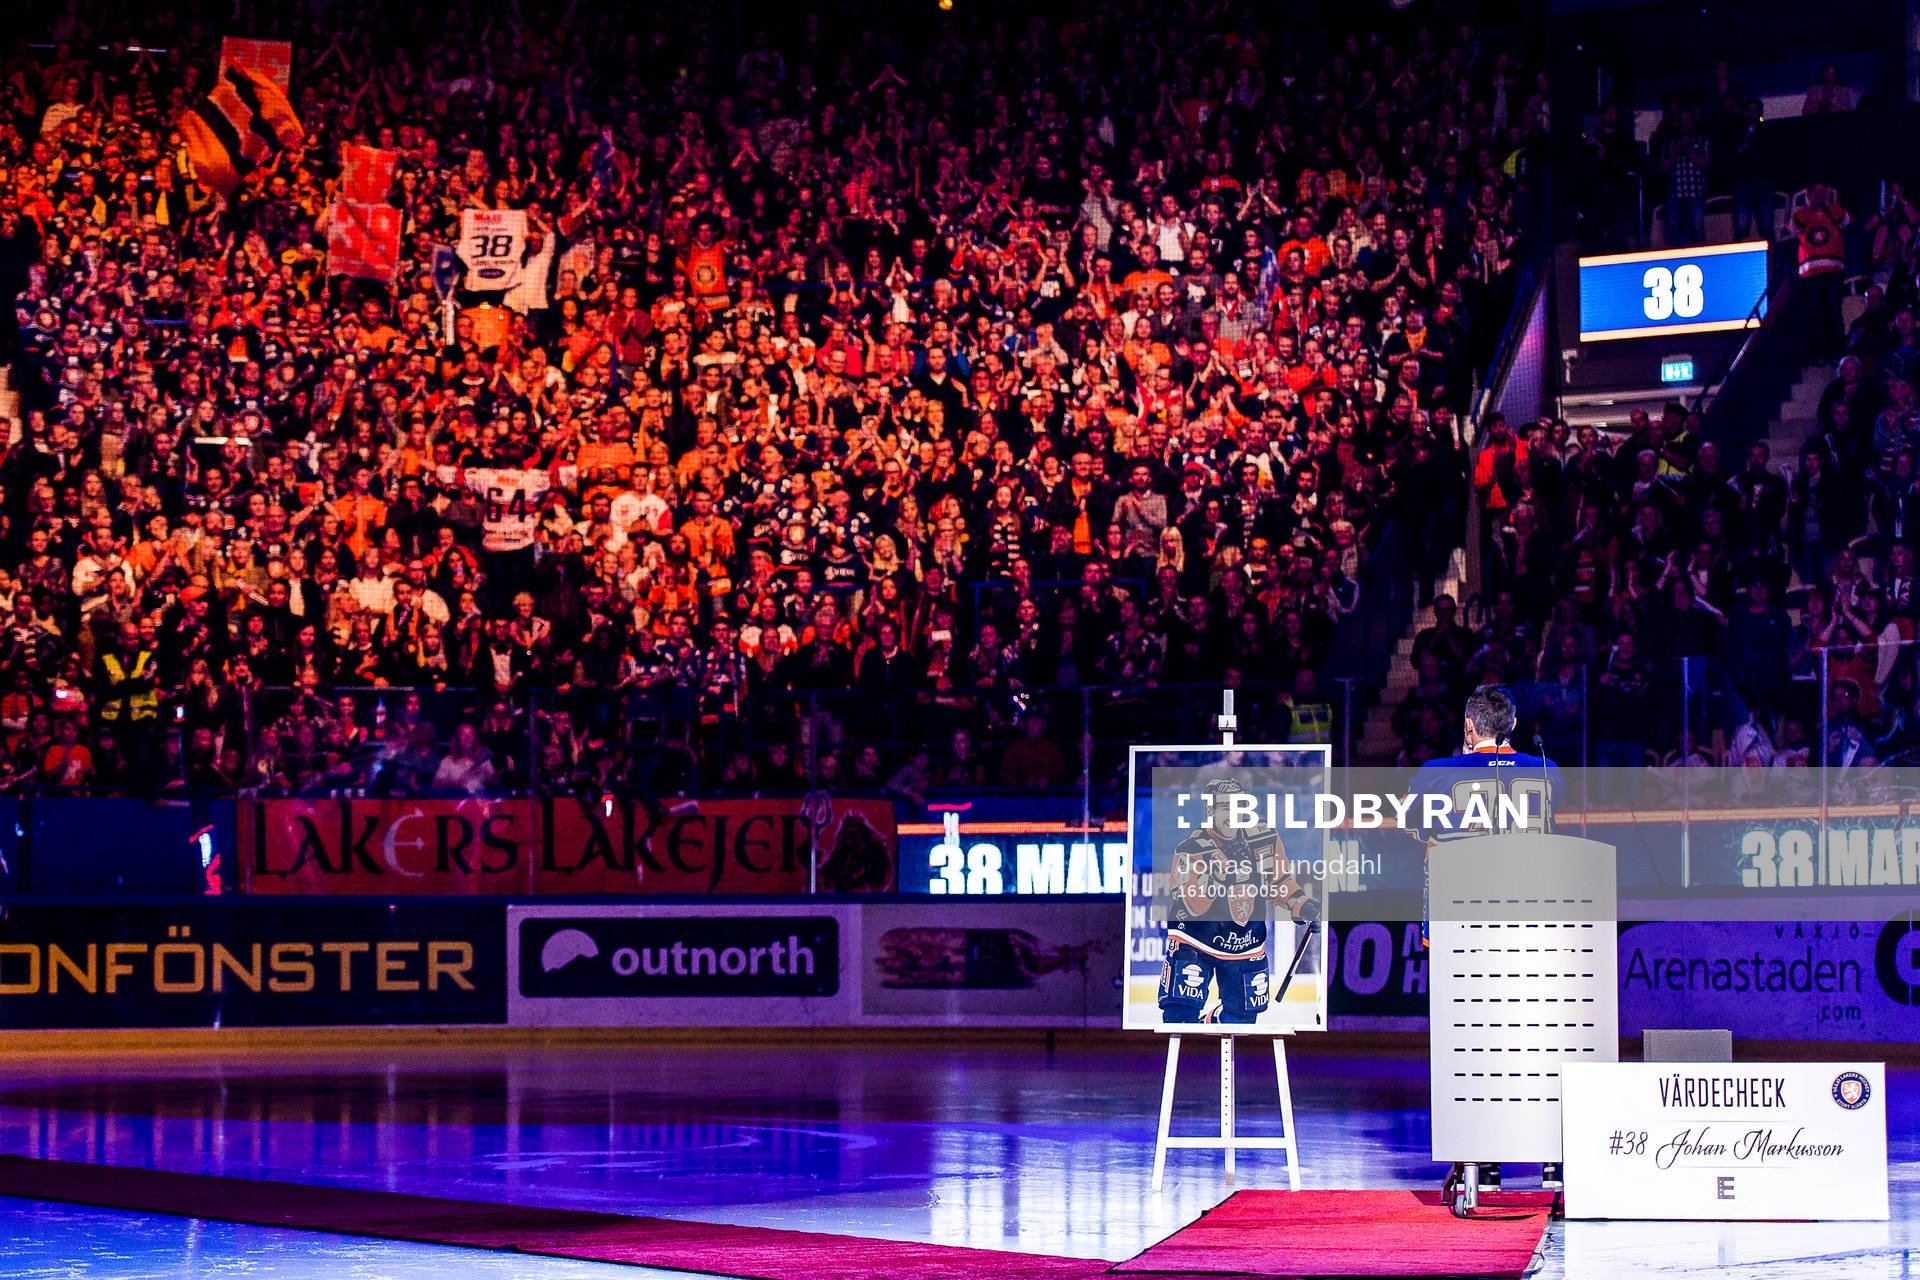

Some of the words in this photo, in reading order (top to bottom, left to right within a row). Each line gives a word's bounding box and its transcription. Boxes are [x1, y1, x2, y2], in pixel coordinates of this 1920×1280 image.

[471, 235, 513, 258] 38
[1643, 264, 1704, 320] 38
[487, 488, 525, 522] 64
[253, 798, 518, 878] LAKERS
[1741, 830, 1814, 888] 38
[929, 843, 1003, 894] 38
[0, 926, 475, 994] ONFÖNSTER
[611, 935, 815, 976] outnorth
[1624, 946, 1861, 993] Arenastaden
[1178, 984, 1204, 999] VIDA
[1659, 1074, 1786, 1108] VÄRDECHECK
[1609, 1130, 1649, 1156] #38
[1655, 1126, 1727, 1170] Johan
[1733, 1127, 1845, 1163] Markusson
